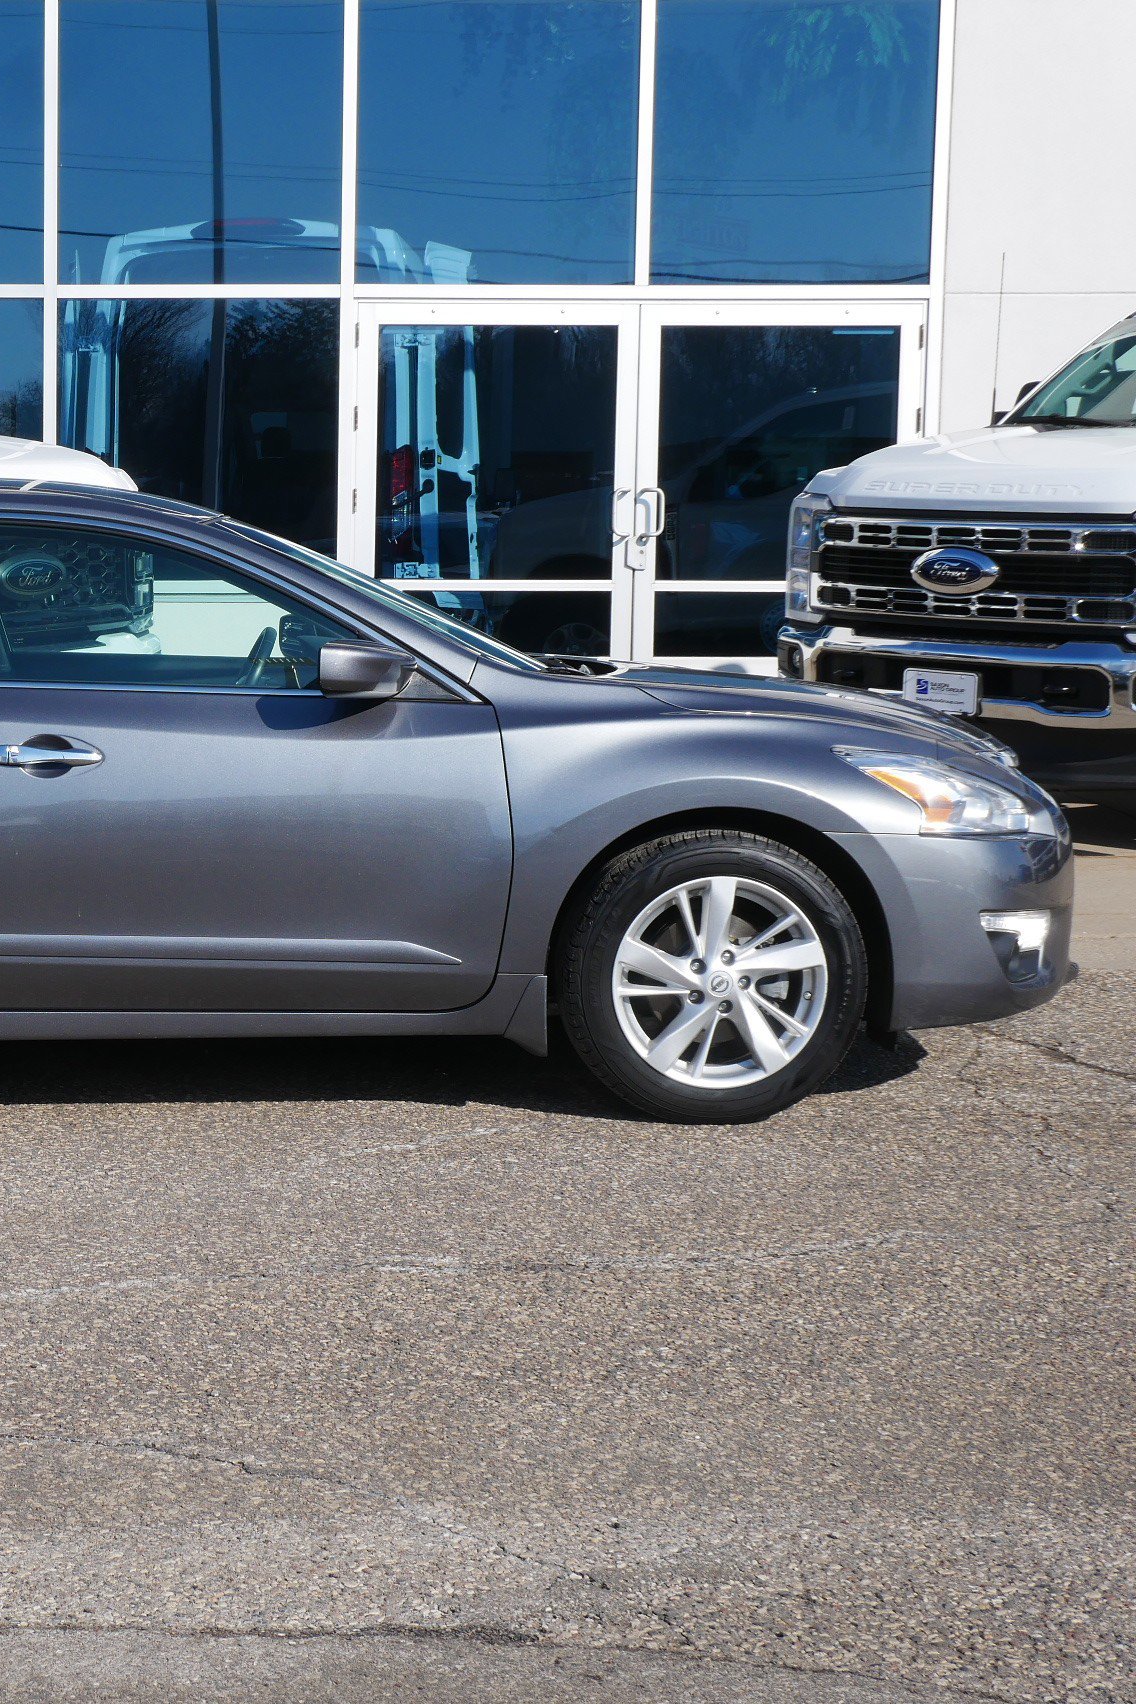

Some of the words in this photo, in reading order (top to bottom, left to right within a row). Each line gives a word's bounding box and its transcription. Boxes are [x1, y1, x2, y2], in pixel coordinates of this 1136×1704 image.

[864, 480, 980, 495] SUPER
[983, 483, 1084, 497] DUTY
[18, 566, 53, 587] Ford
[930, 560, 969, 581] Ford
